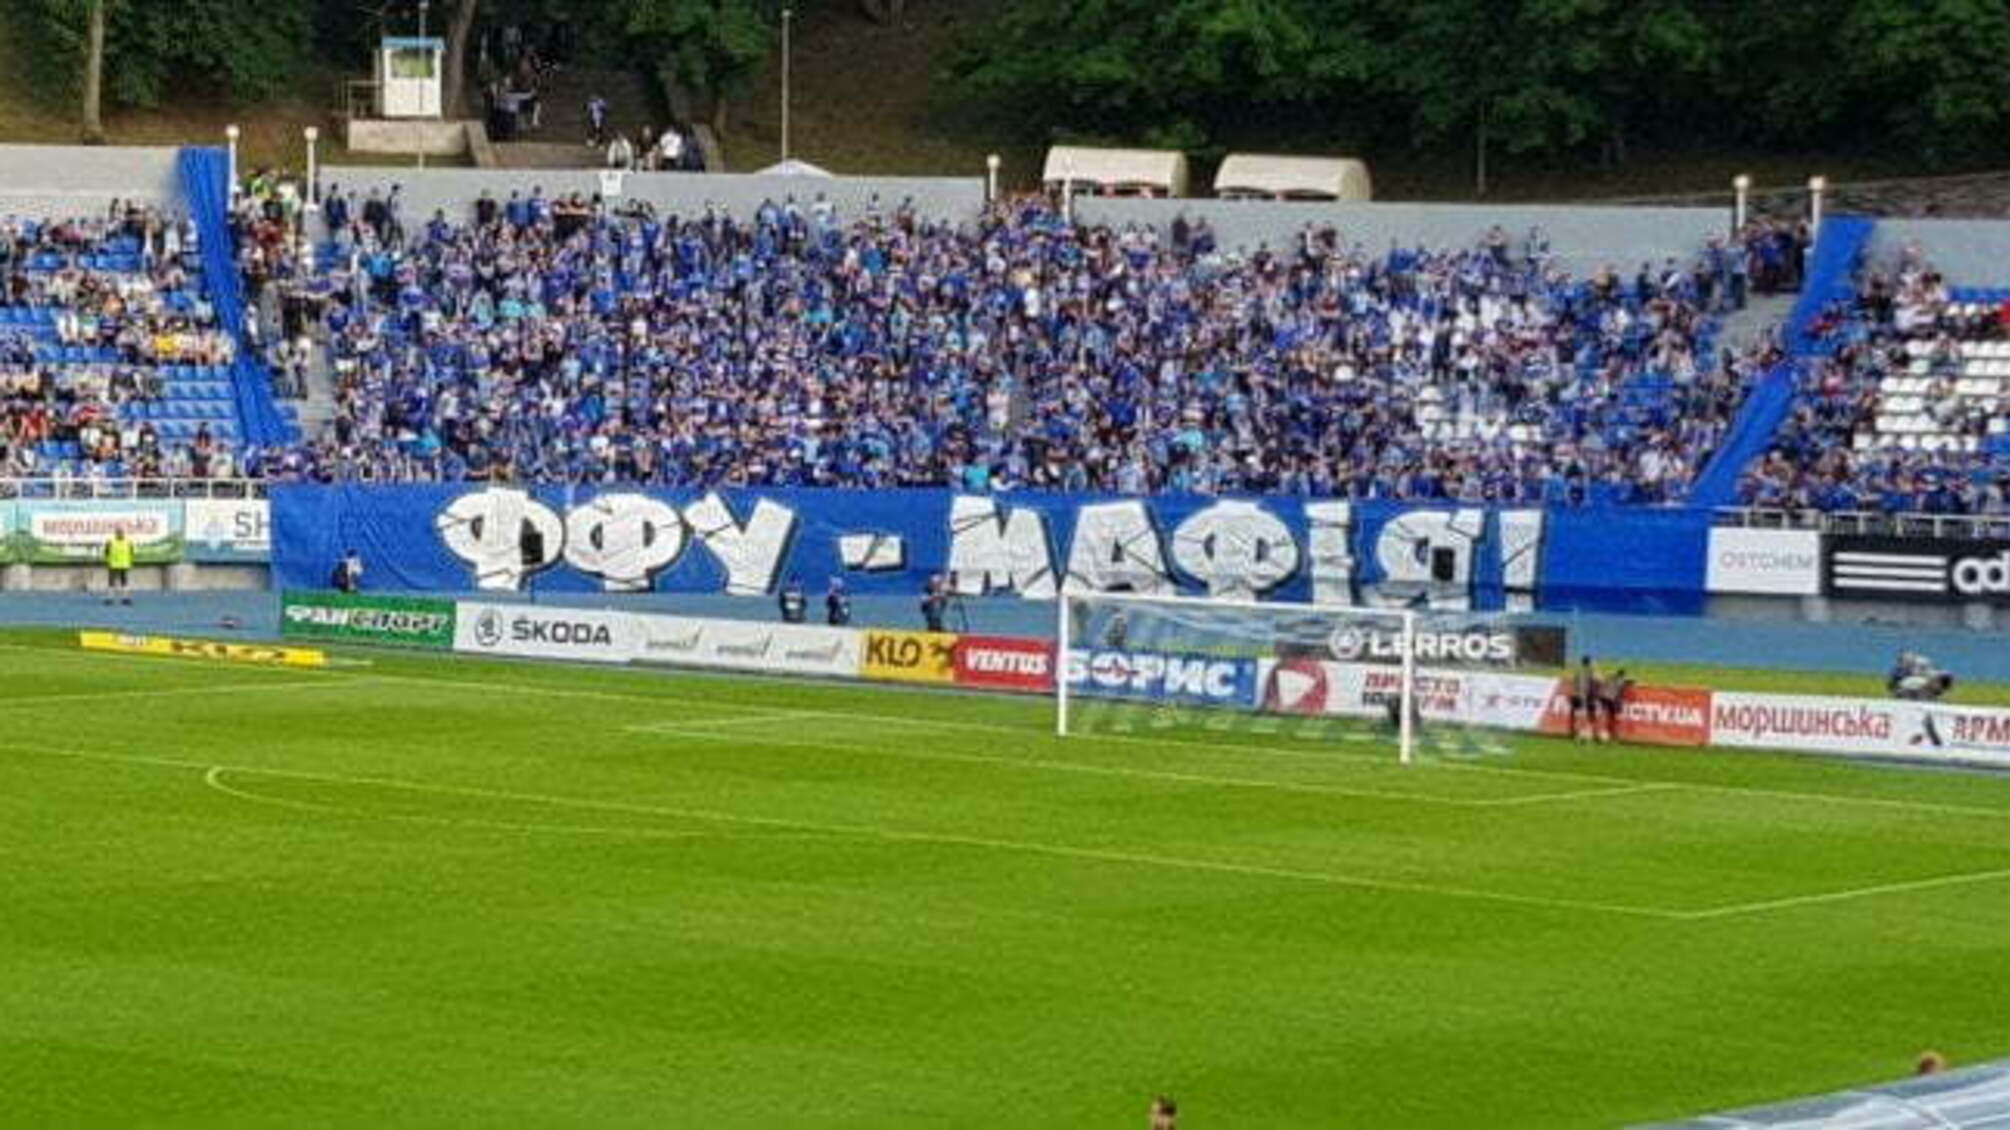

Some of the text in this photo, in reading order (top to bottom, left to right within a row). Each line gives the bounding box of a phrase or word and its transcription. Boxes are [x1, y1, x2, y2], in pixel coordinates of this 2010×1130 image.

[437, 487, 794, 595] ФФУ
[866, 634, 922, 668] KLO
[965, 646, 1050, 676] VENTUS
[1063, 650, 1237, 697] БОРИС
